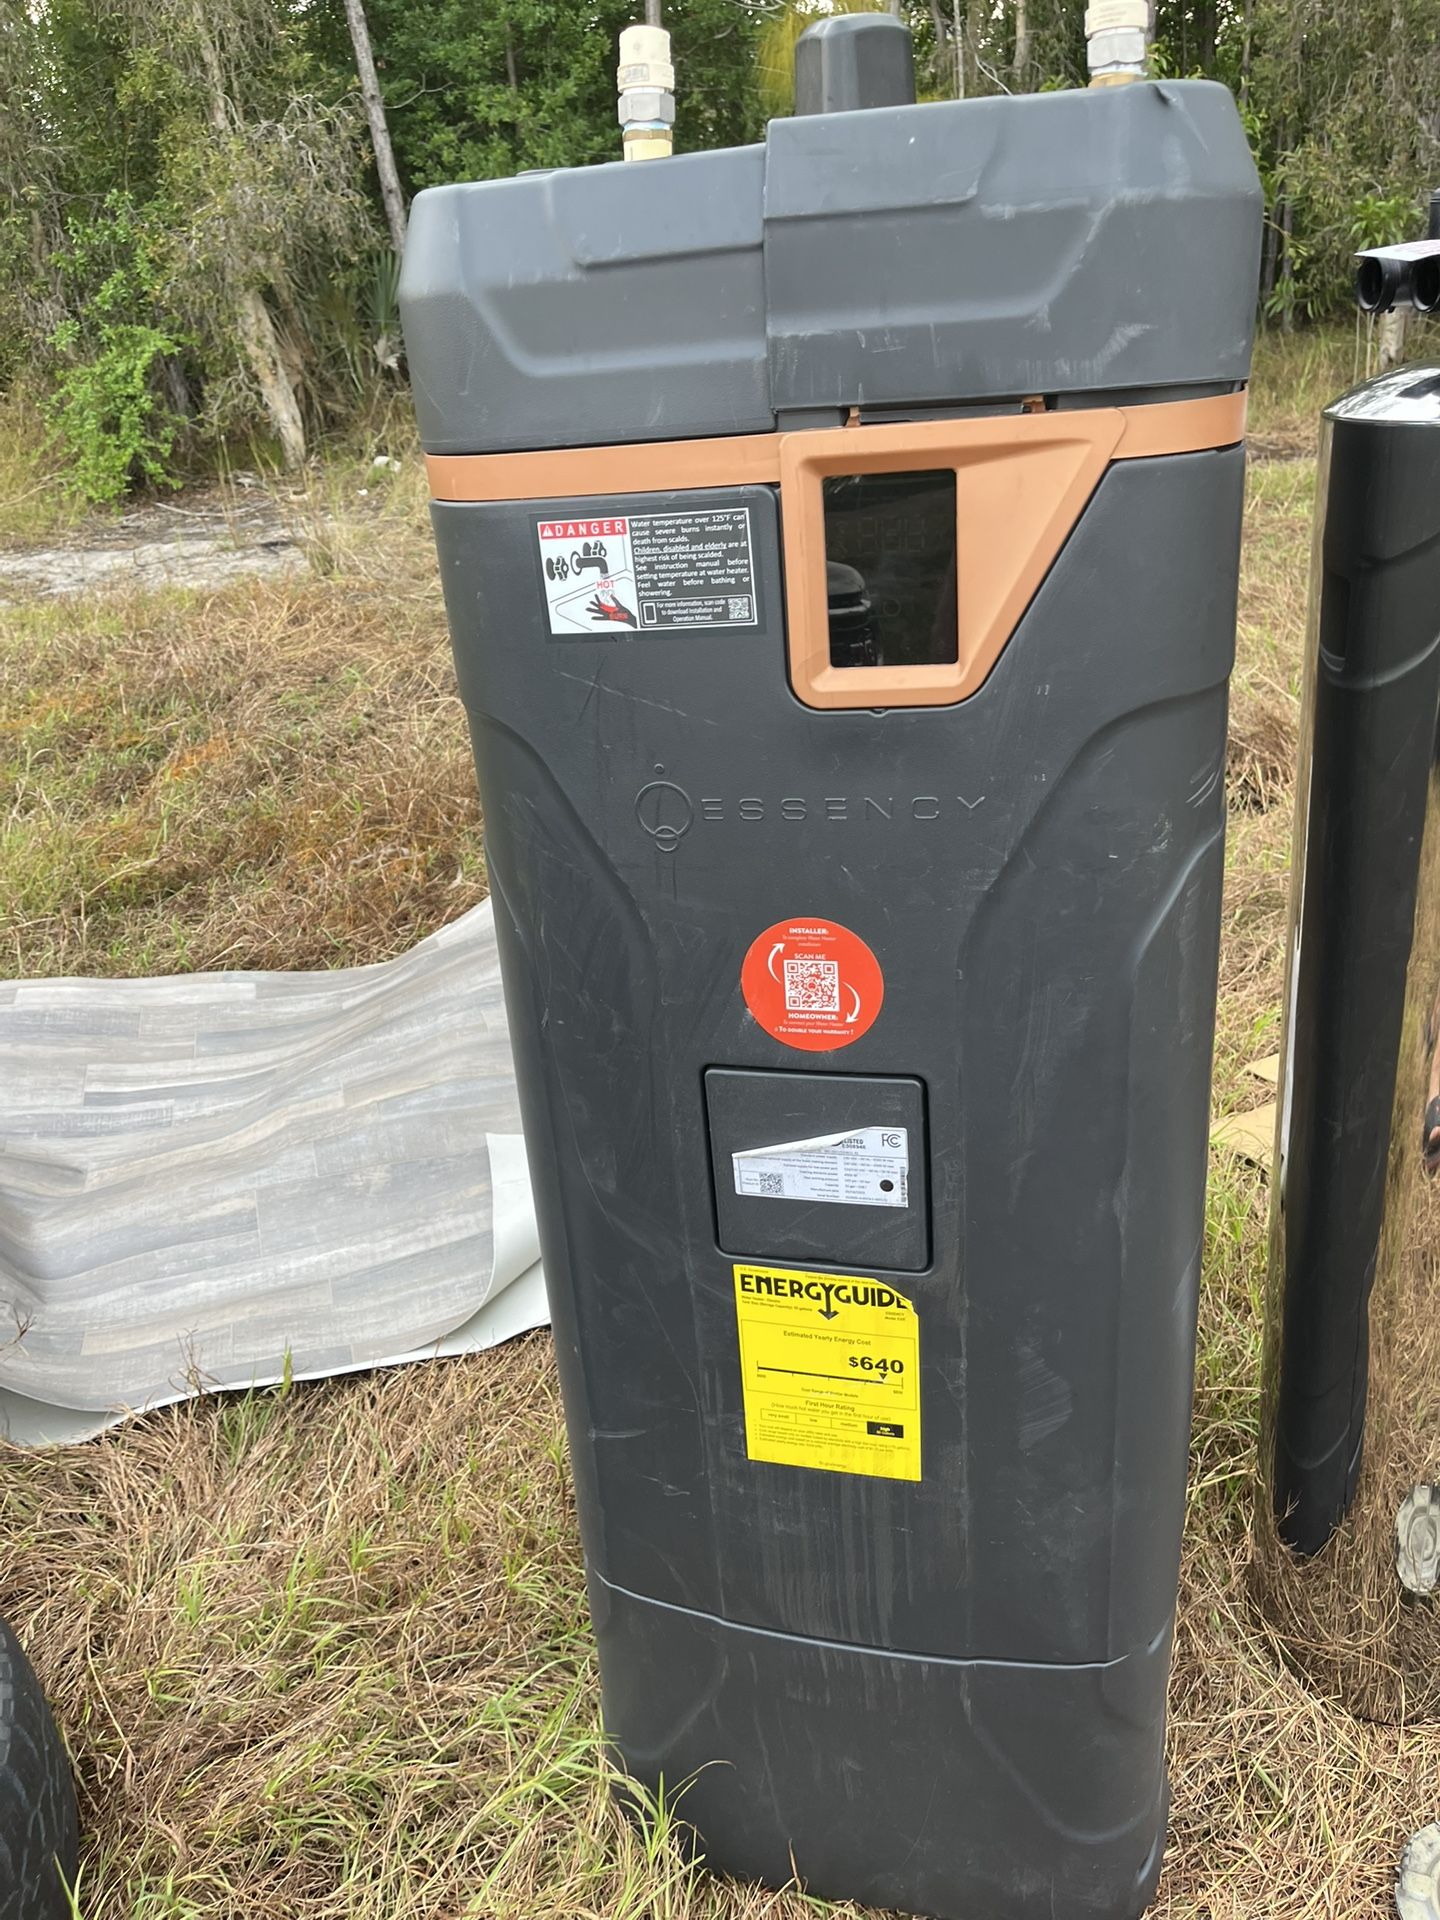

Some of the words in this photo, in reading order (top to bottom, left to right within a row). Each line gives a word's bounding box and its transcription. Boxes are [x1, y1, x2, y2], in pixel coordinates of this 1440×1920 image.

[555, 521, 624, 536] DANGER
[630, 520, 650, 528] Water
[652, 518, 692, 527] temperature
[705, 524, 732, 532] instantly
[663, 545, 690, 553] disabled
[705, 542, 727, 550] elderly
[679, 552, 697, 560] being
[654, 562, 688, 570] instruction
[727, 558, 748, 566] before
[659, 570, 698, 579] temperature
[596, 580, 614, 589] HOT
[701, 796, 986, 821] ESSENCY
[881, 1133, 901, 1148] FCC
[783, 1330, 813, 1339] Estimated
[814, 1334, 833, 1342] Yearly
[834, 1336, 855, 1345] Energy
[848, 1356, 904, 1374] $640
[836, 1404, 855, 1412] Rating
